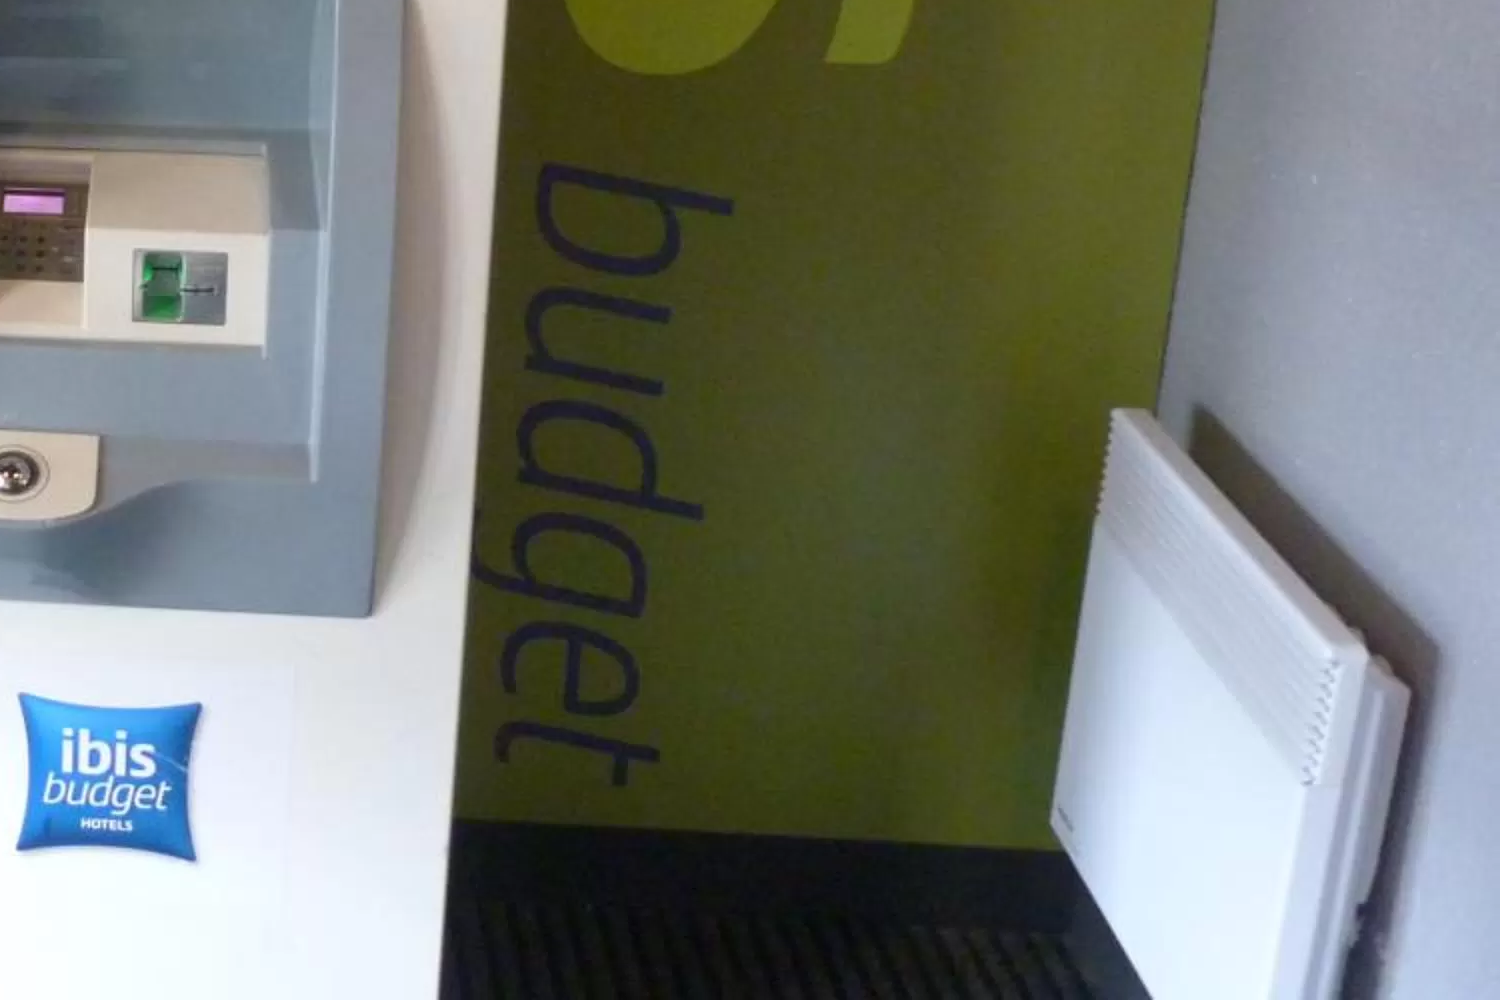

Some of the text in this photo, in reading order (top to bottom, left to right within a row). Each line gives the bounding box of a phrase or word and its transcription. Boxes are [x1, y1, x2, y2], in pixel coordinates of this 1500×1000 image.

[471, 162, 734, 786] budget
[61, 727, 157, 778] ibis
[43, 771, 173, 816] budget
[80, 817, 134, 831] HOTELS
